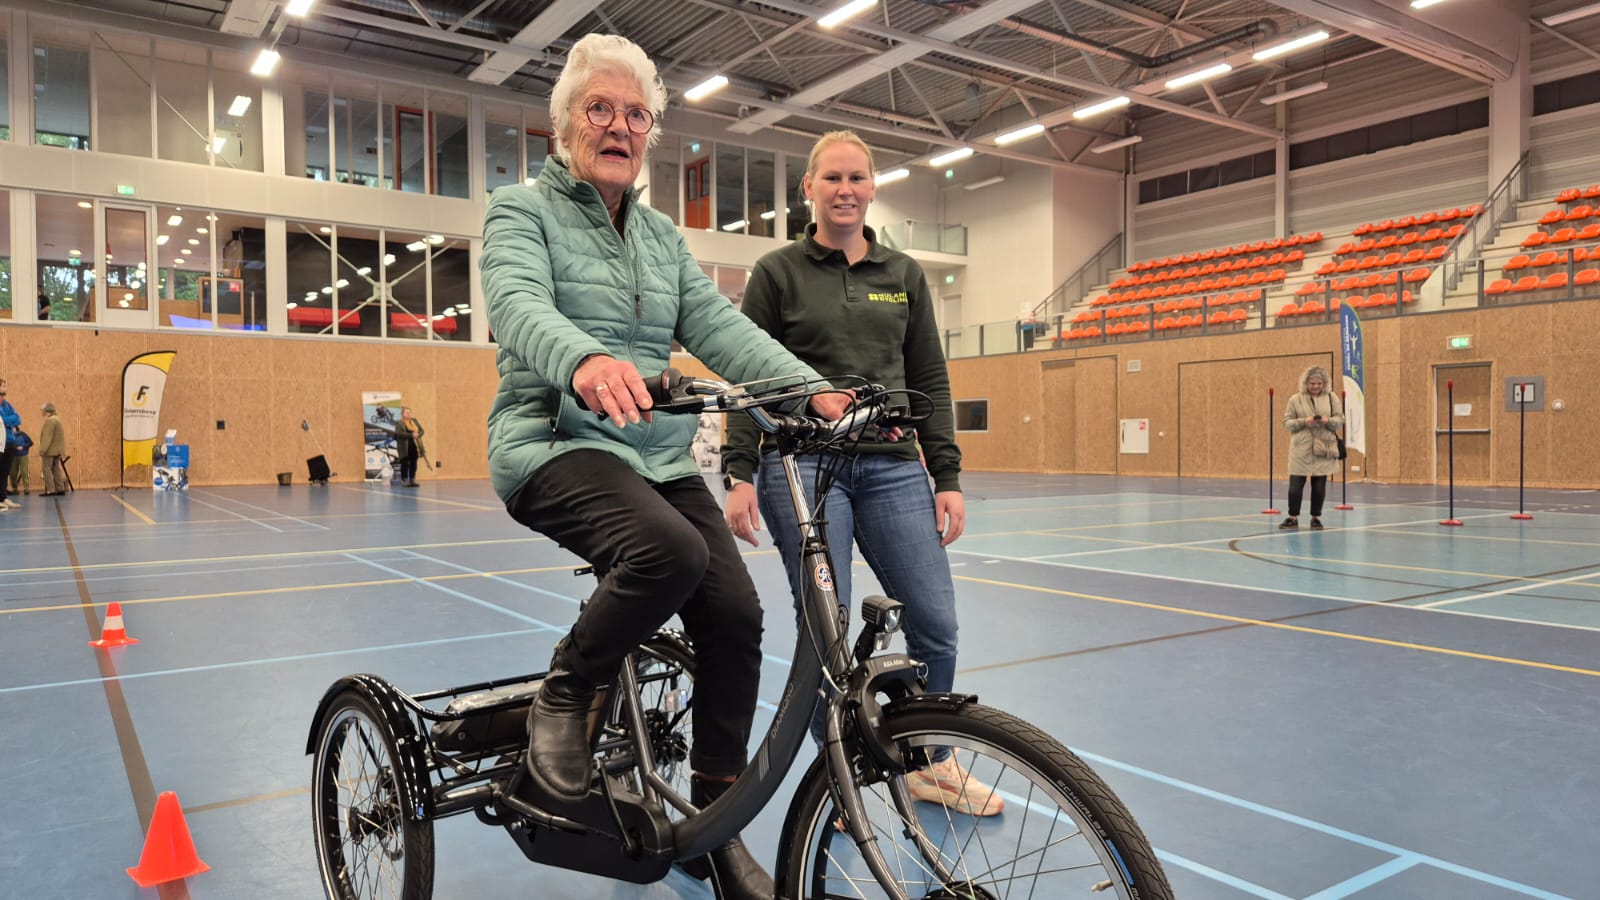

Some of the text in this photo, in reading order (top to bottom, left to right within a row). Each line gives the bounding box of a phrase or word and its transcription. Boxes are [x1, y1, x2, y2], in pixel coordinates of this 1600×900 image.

[136, 385, 150, 401] F
[771, 682, 794, 741] DIAMOND
[1056, 779, 1107, 837] SCHWALBE
